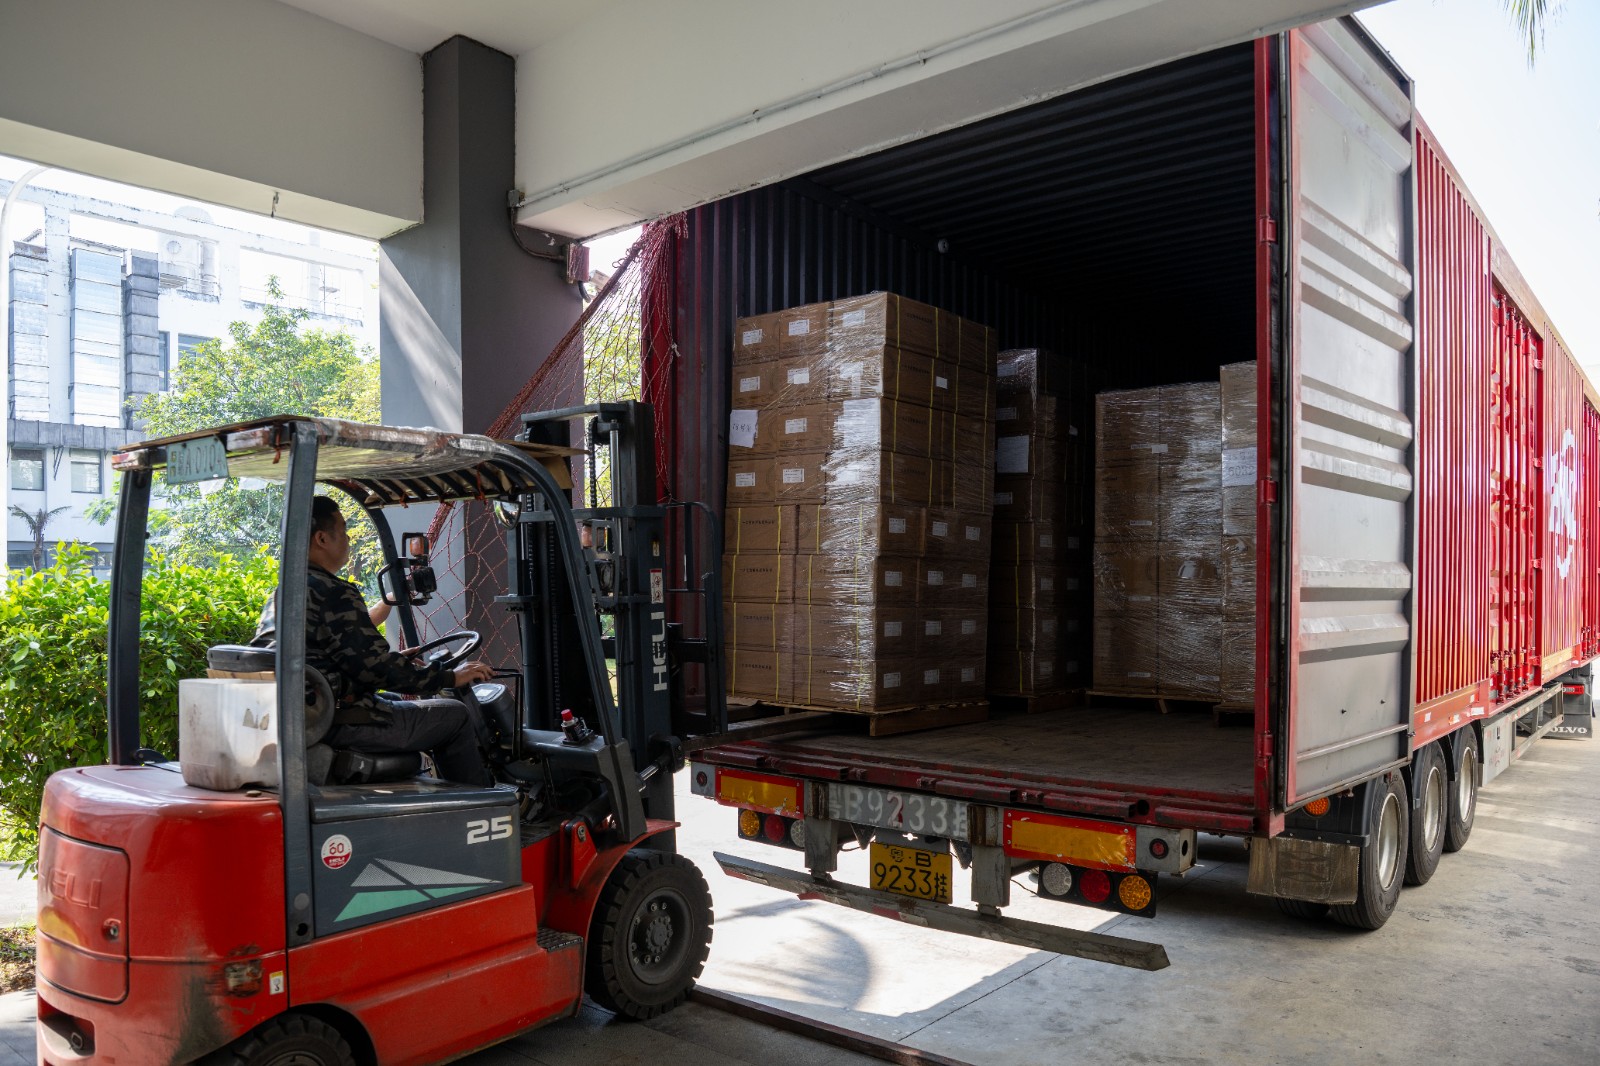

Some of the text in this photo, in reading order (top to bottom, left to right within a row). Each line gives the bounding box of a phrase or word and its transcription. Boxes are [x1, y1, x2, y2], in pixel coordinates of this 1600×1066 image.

[650, 610, 668, 692] HELI
[1538, 725, 1588, 734] OLVO
[466, 815, 513, 845] 25
[329, 842, 345, 855] 60
[874, 862, 948, 901] 9233挂
